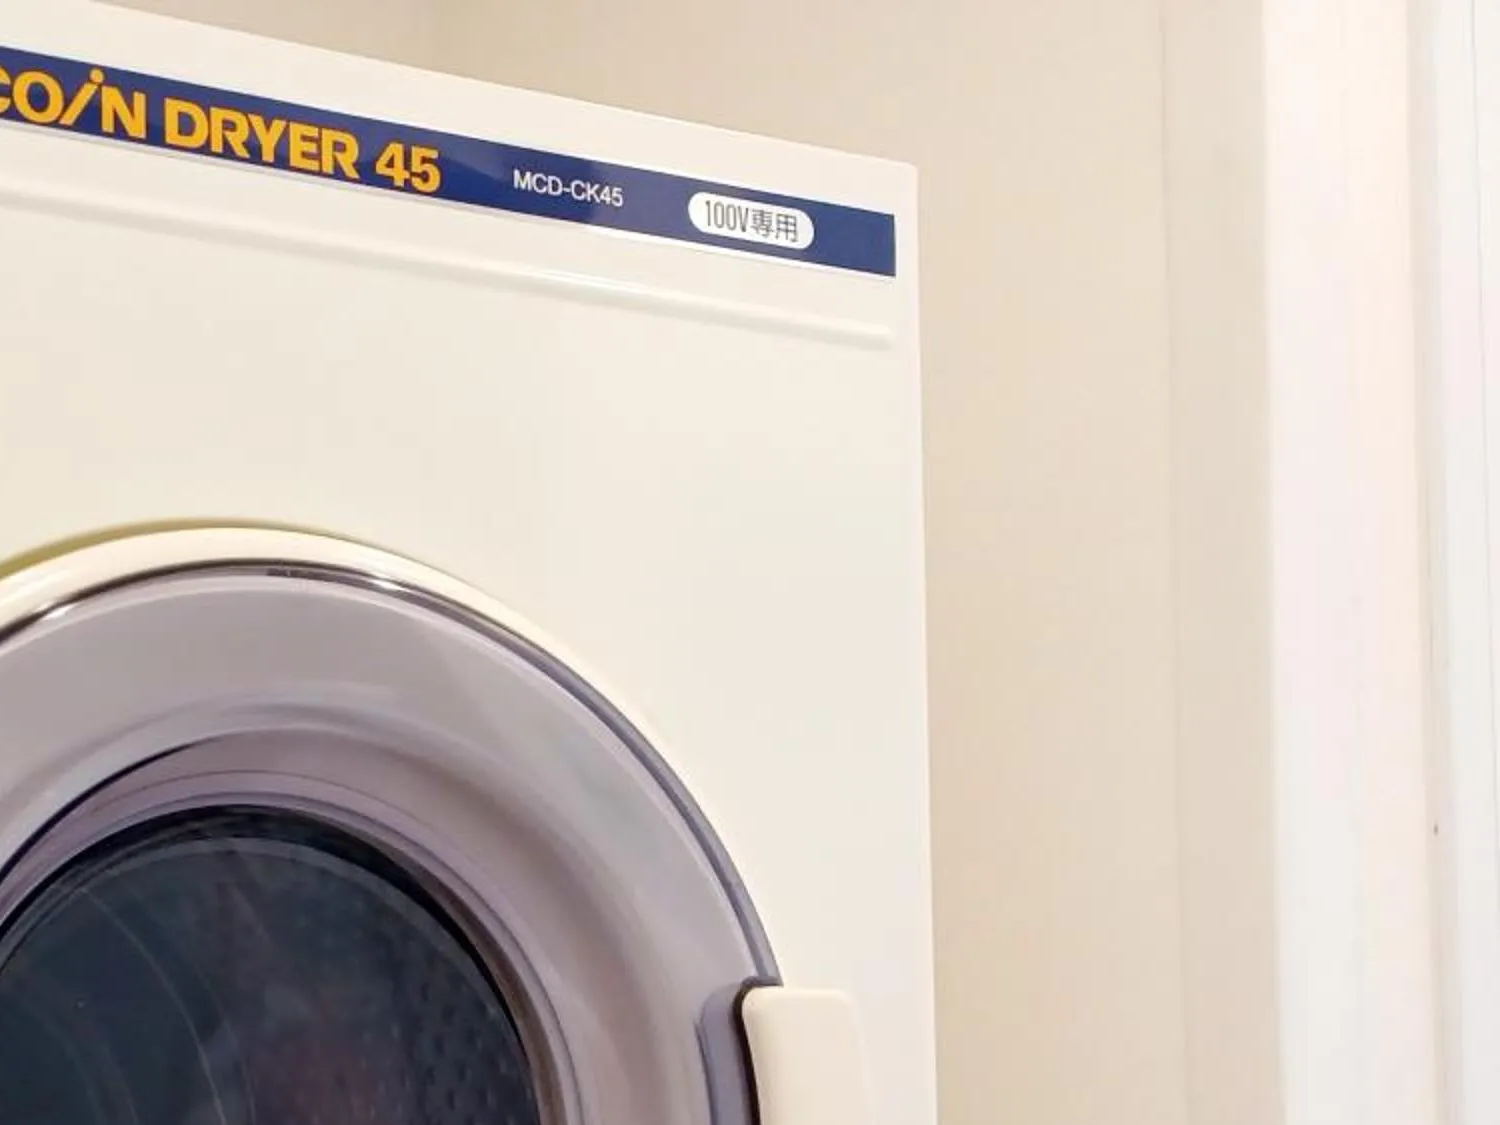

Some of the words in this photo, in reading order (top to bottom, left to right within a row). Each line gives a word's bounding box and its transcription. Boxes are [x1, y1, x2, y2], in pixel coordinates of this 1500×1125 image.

[163, 97, 360, 179] DRYER
[374, 143, 441, 192] 45
[512, 168, 624, 208] MCD-CK45
[703, 199, 799, 243] 100V専用
